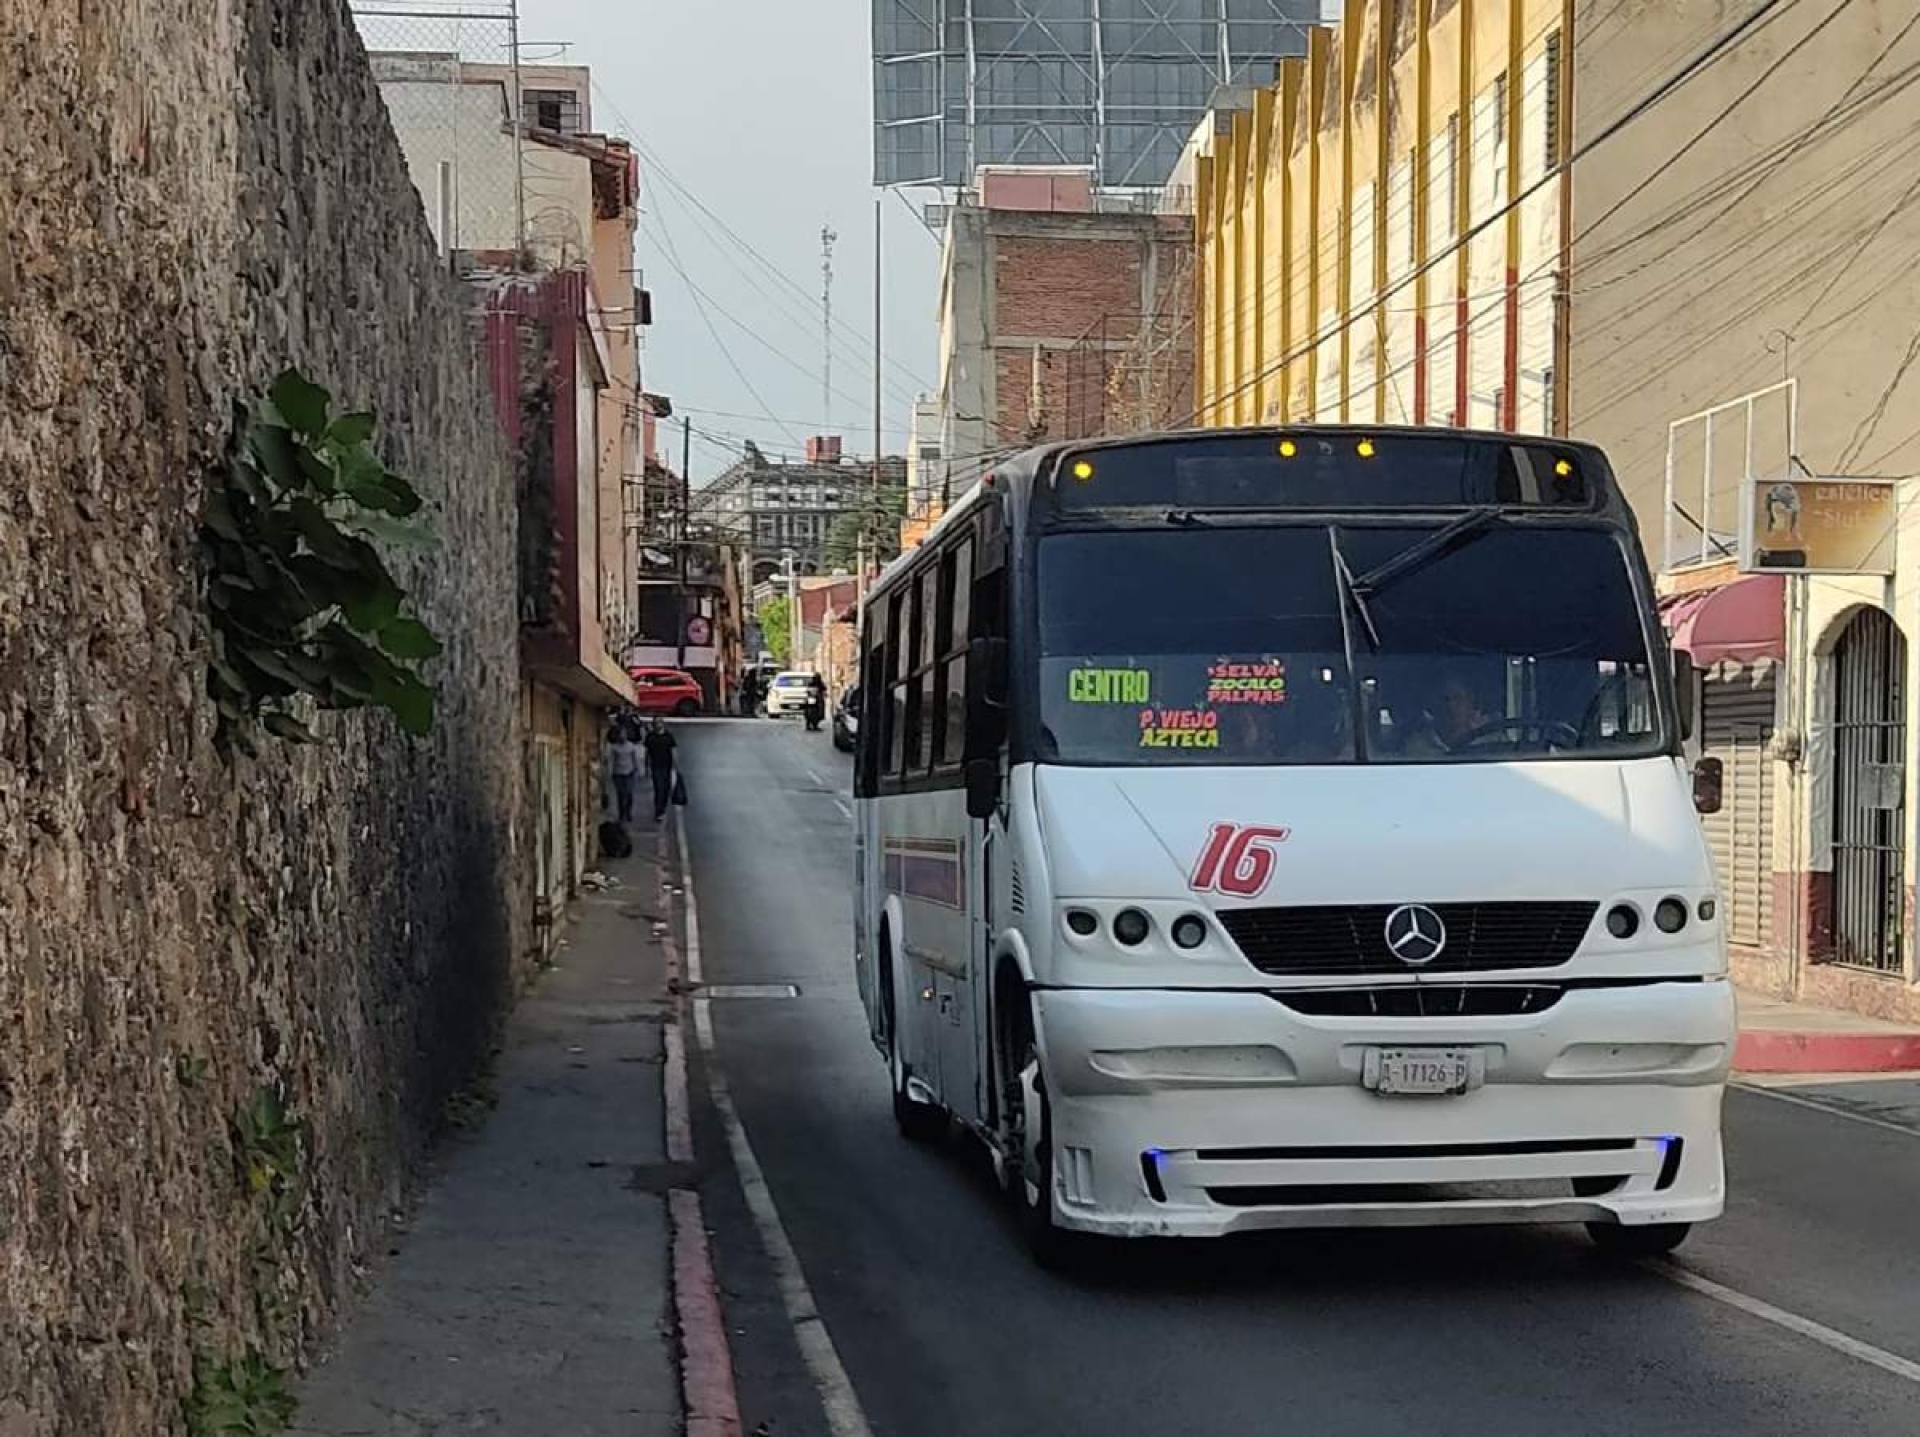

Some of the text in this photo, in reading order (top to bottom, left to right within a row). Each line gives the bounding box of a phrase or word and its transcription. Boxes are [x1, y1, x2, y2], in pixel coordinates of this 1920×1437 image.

[1069, 669, 1149, 703] CENTRO
[1209, 678, 1284, 690] ZOCALO
[1208, 690, 1285, 703] PALMAS
[1139, 709, 1217, 728] P. VIEJO
[1139, 727, 1219, 747] AZTECA
[1189, 821, 1291, 899] 16
